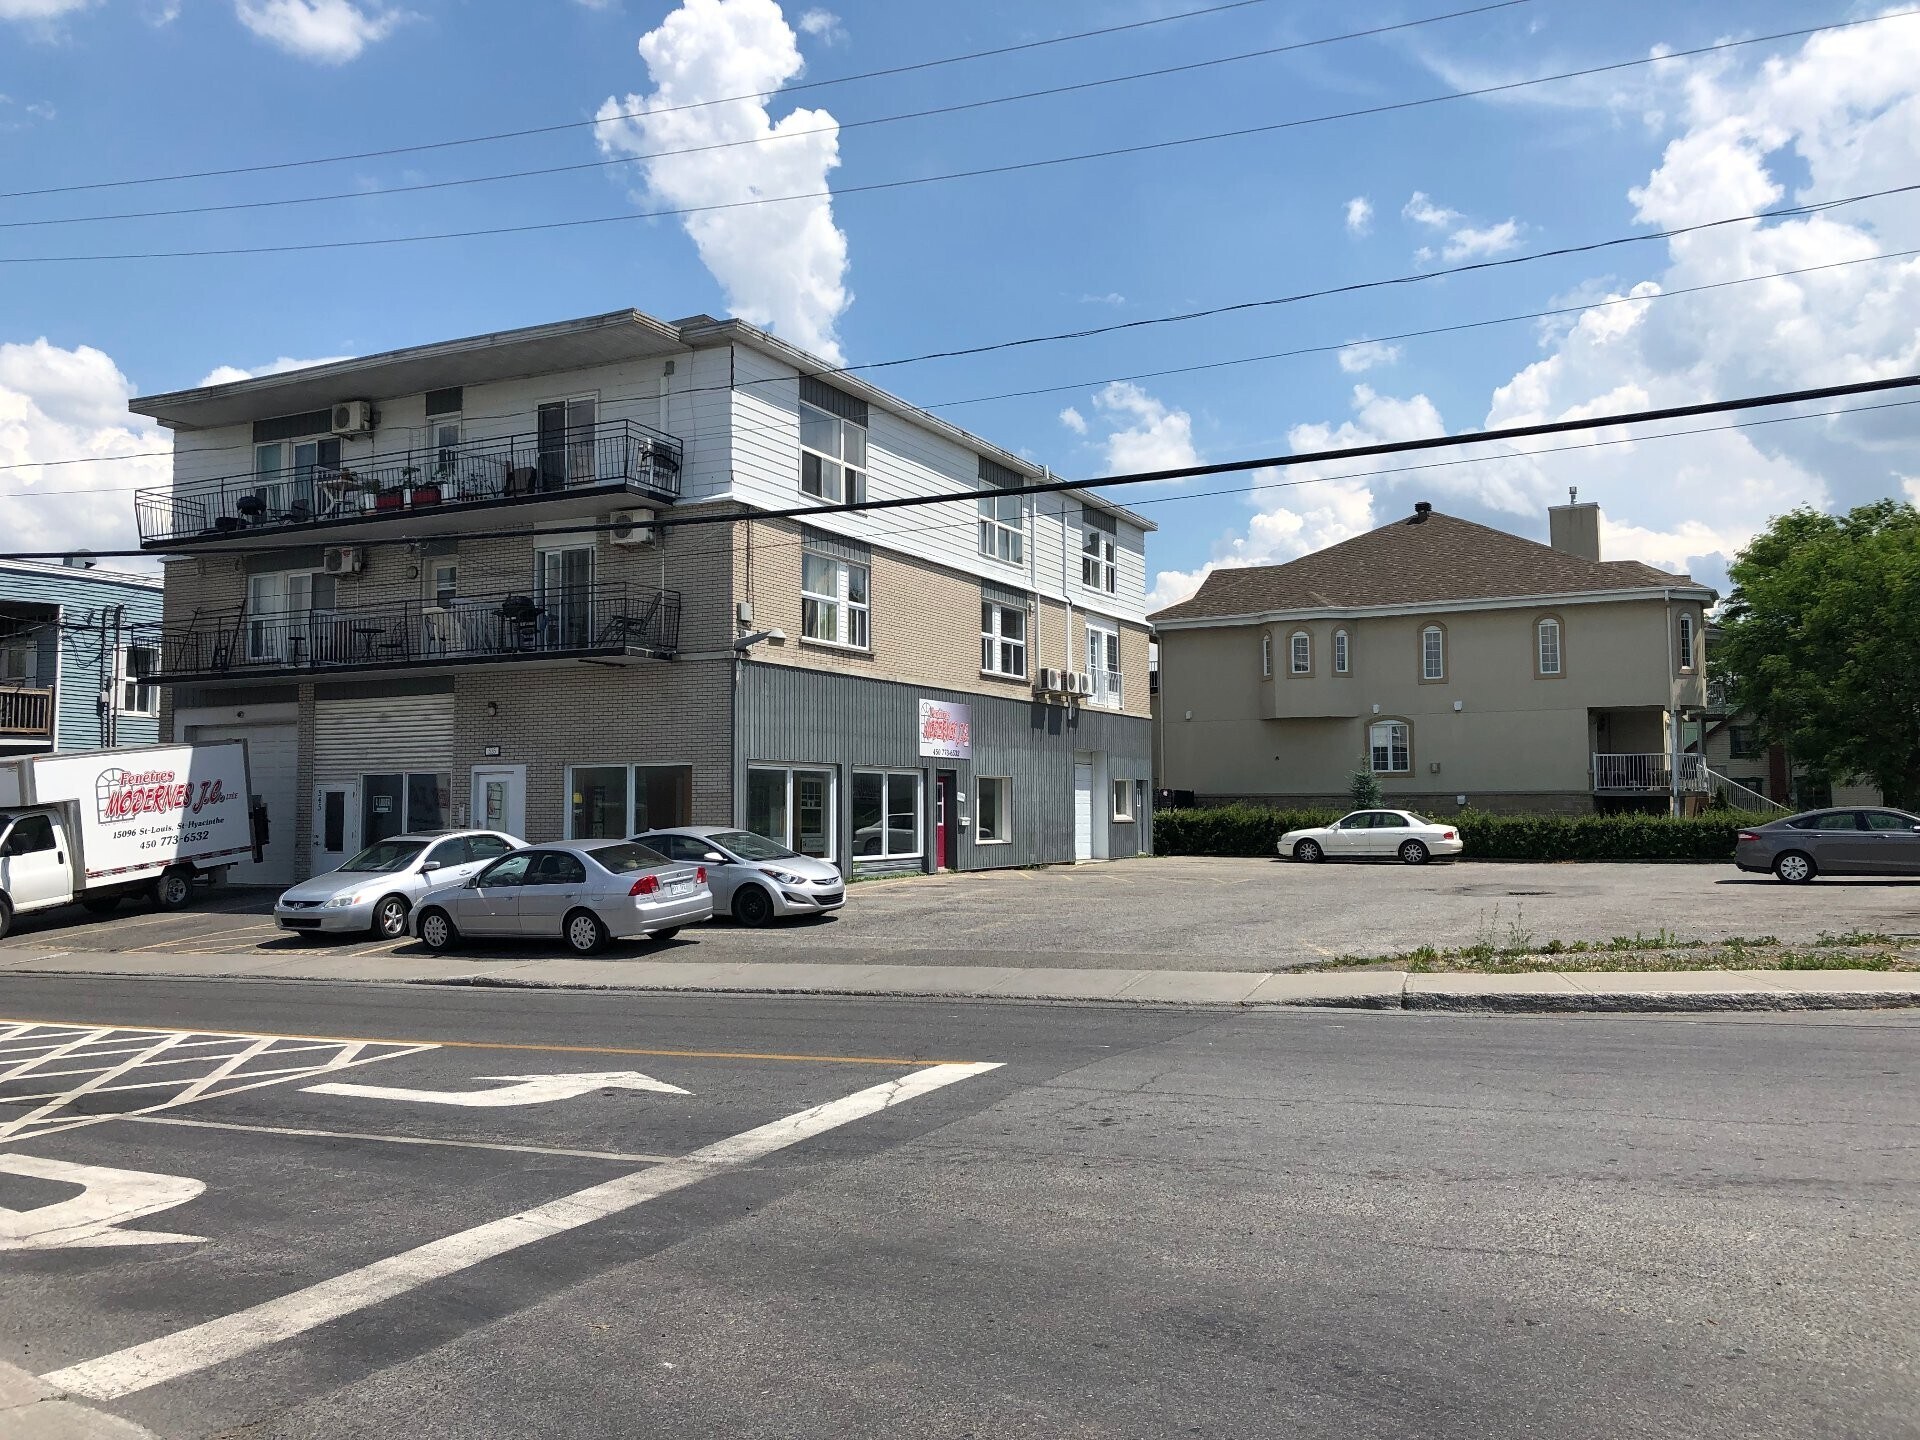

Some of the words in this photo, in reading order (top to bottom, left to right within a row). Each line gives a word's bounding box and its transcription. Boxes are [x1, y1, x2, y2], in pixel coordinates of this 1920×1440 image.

[104, 782, 194, 818] MODERNES
[113, 829, 137, 840] 15096
[140, 839, 157, 850] 450
[160, 830, 210, 847] 773-6532
